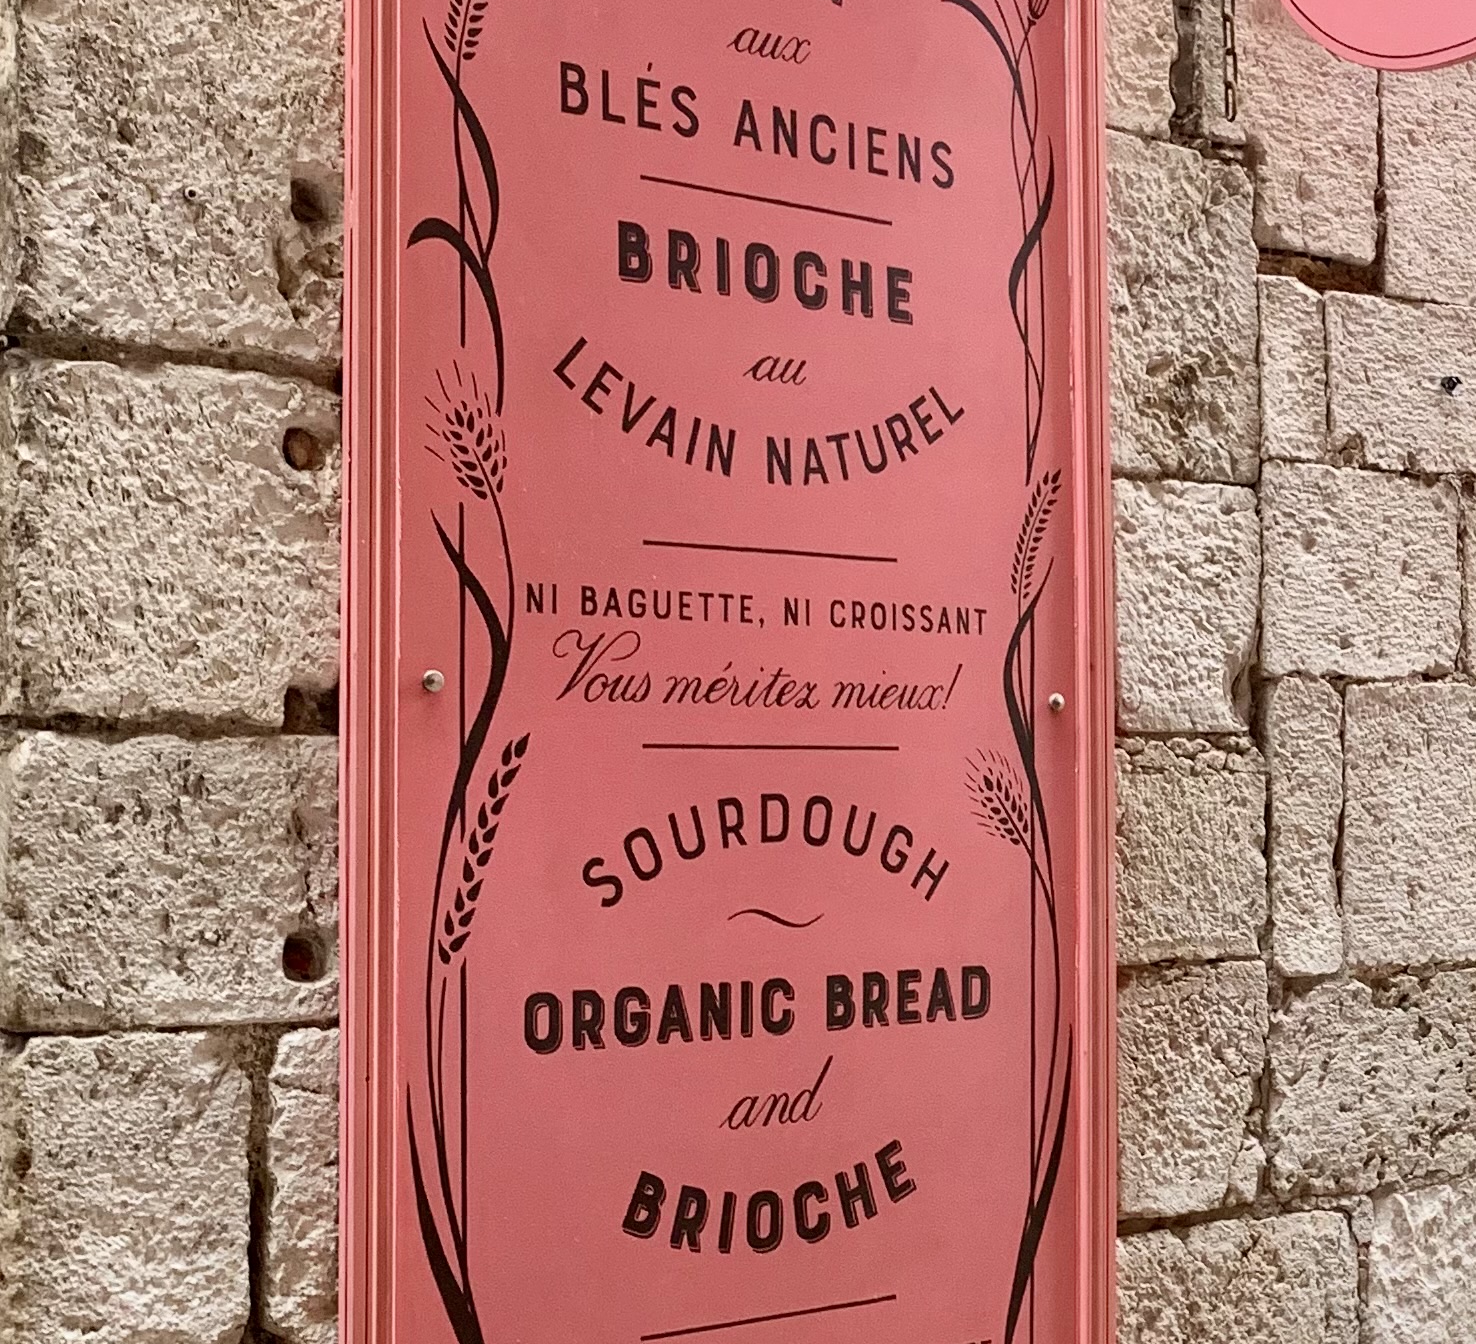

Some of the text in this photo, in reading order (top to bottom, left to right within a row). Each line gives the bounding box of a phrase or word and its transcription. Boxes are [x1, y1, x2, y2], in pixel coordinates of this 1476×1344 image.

[727, 27, 813, 66] aux
[560, 61, 955, 191] BLÉS ANCIENS
[617, 220, 915, 327] BRIOCHE
[553, 336, 967, 487] LEVAIN NATUREL
[743, 355, 808, 387] au
[526, 583, 989, 637] NI BAGUETTE, NI CROISSANT
[552, 629, 964, 712] Vous méritez mieux!
[582, 793, 951, 908] SOURDOUGH
[524, 965, 993, 1056] ORGANIC BREAD
[719, 1055, 835, 1131] and
[621, 1139, 918, 1256] BRIOCHE
